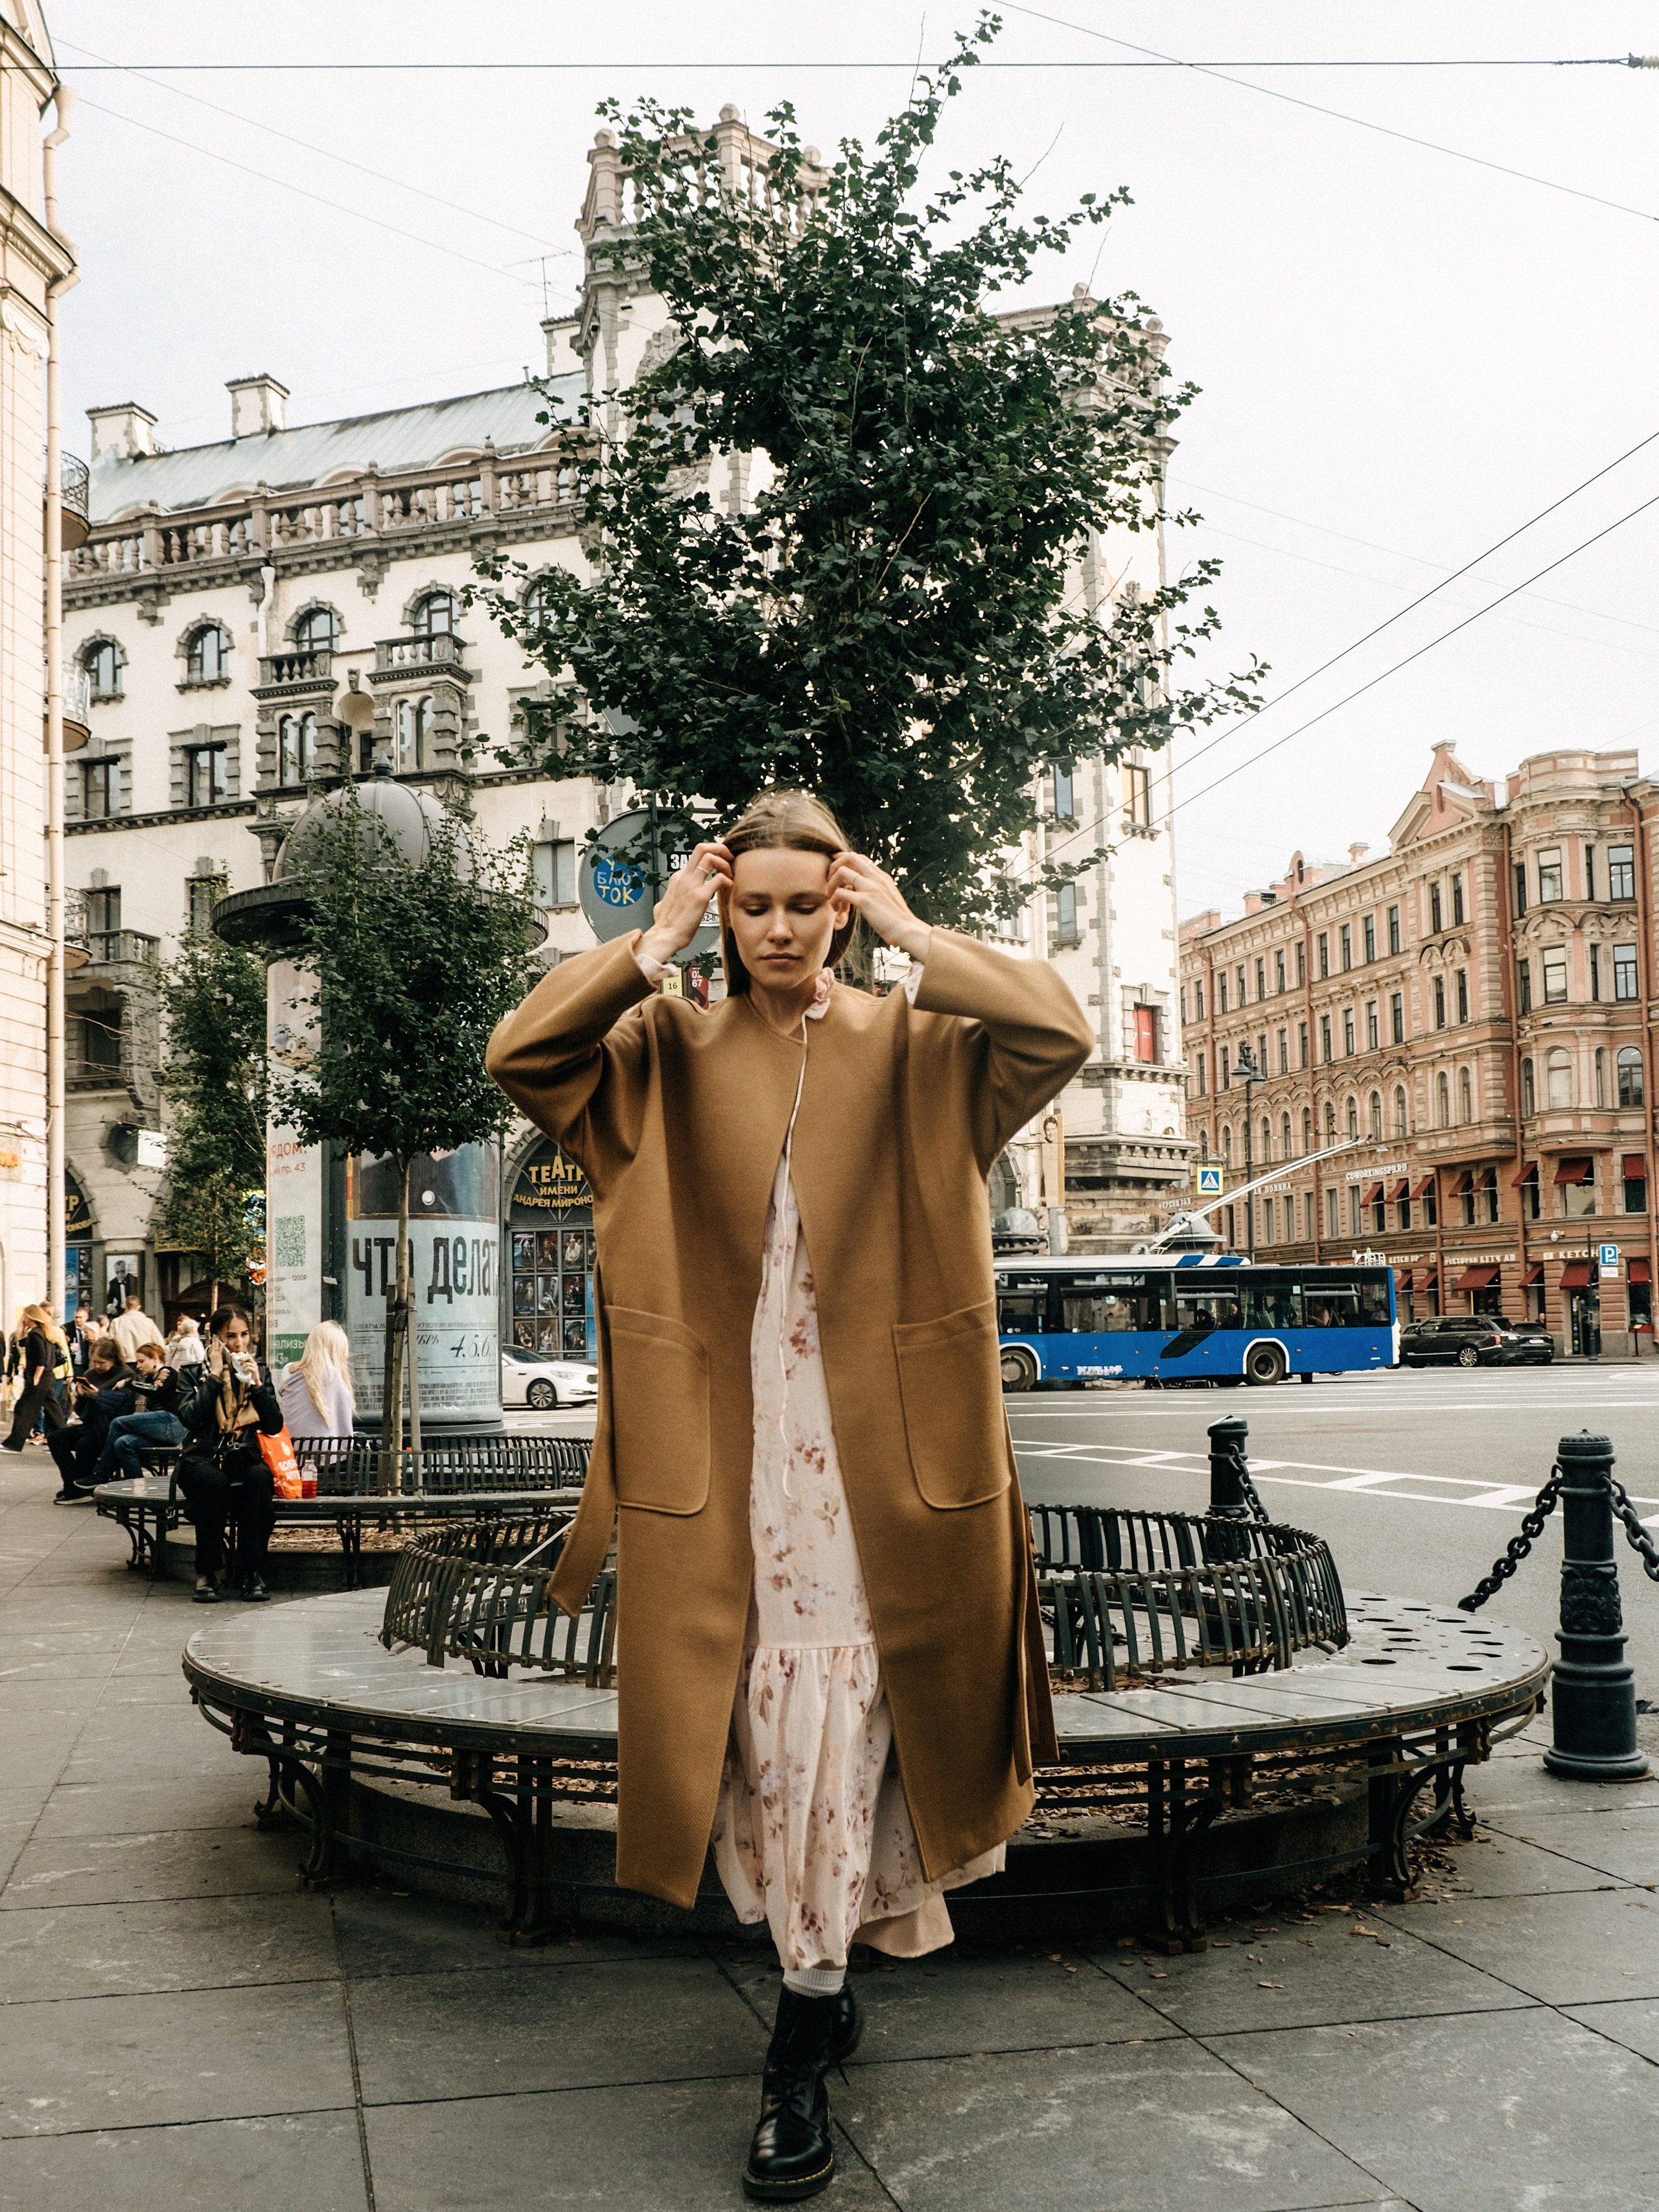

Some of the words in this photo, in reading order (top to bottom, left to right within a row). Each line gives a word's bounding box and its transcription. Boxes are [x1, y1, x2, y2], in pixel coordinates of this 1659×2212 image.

[670, 854, 693, 870] ЗА
[597, 885, 635, 905] ТОК
[691, 979, 703, 988] 67
[294, 1163, 306, 1172] 43
[540, 1185, 578, 1196] ИМЕНИ
[1264, 1182, 1292, 1194] ПОЛЯНА
[513, 1194, 551, 1207] АНДРЕЯ
[551, 1194, 594, 1207] МИРОНО
